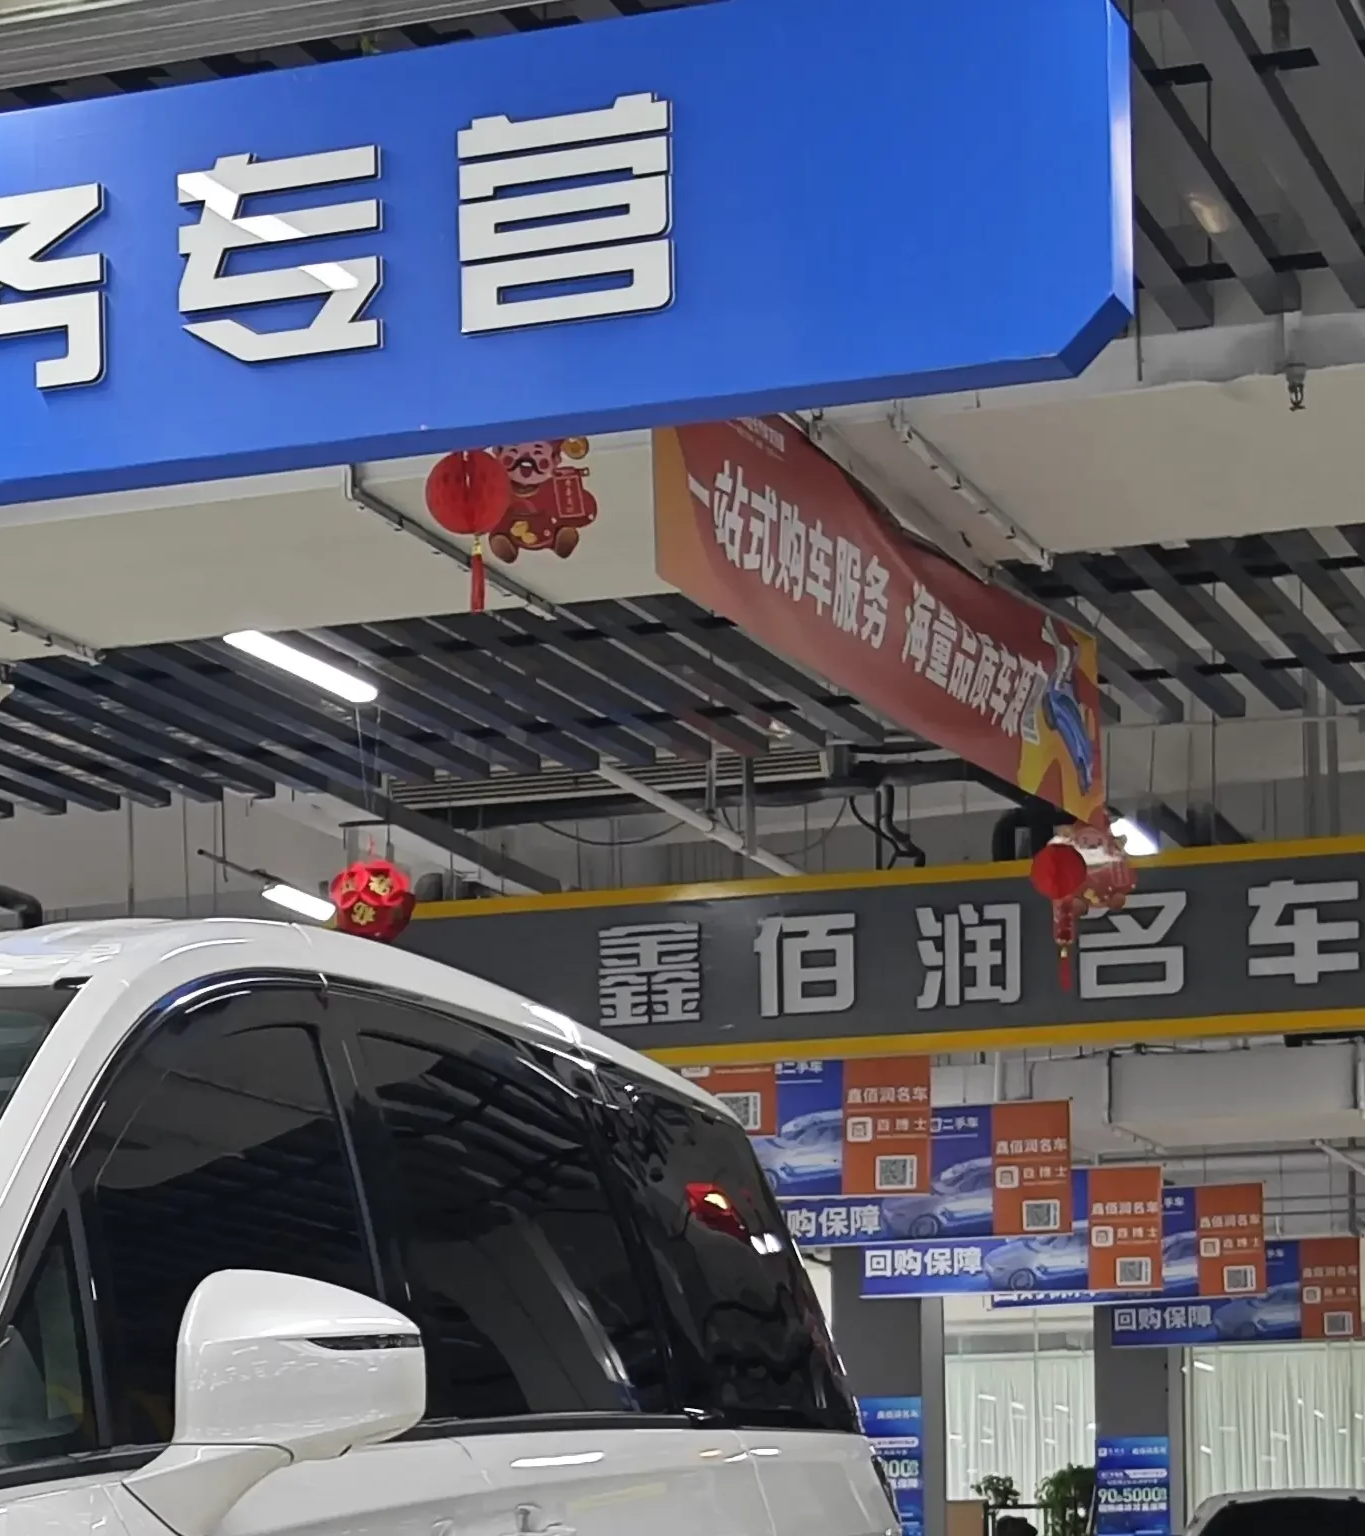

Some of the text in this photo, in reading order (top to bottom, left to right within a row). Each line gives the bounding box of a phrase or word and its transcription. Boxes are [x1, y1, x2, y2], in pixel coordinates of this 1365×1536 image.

[687, 459, 891, 650] 一站式购车服务
[598, 880, 1361, 1028] 鑫佰润名车
[783, 1204, 882, 1238] 购保障
[864, 1246, 983, 1278] 回购保障
[1113, 1304, 1213, 1331] 回购保障
